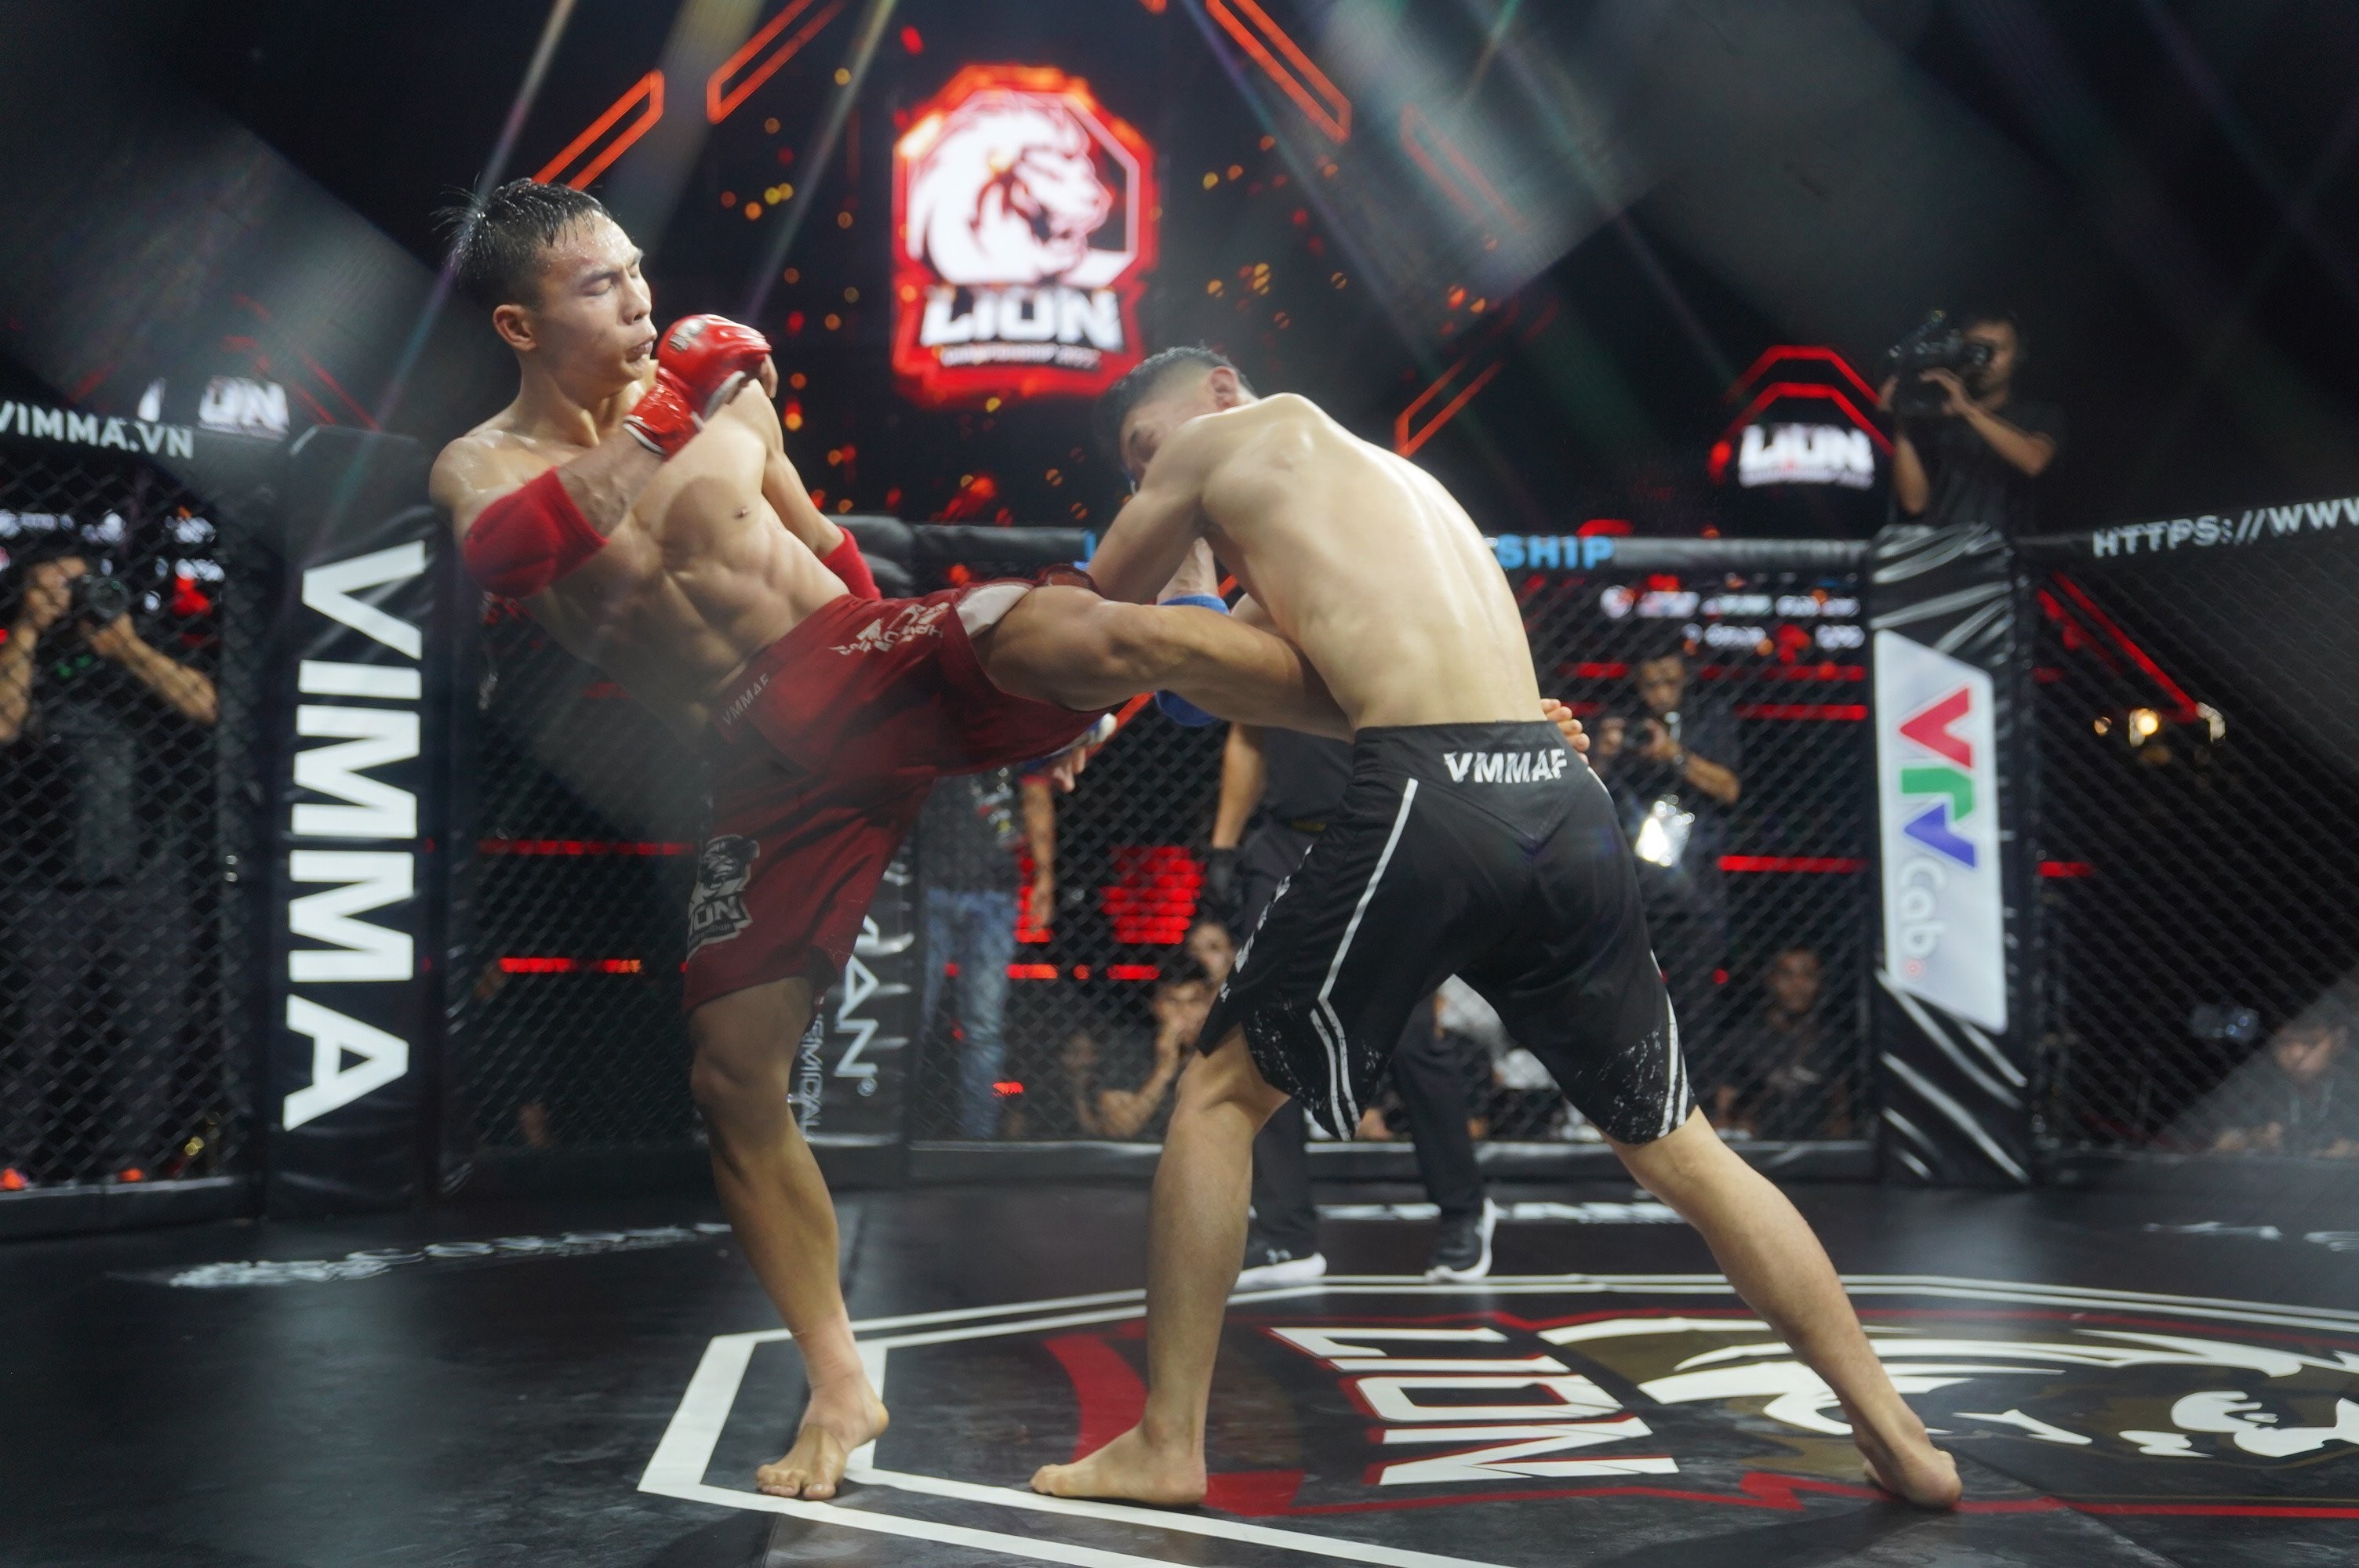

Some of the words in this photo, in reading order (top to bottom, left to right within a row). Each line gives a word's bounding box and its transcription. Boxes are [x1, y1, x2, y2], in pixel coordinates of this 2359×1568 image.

[920, 284, 1124, 352] LION
[1443, 748, 1568, 784] VMMAF
[282, 539, 426, 1132] VIMMA
[1270, 1327, 1680, 1486] LION
